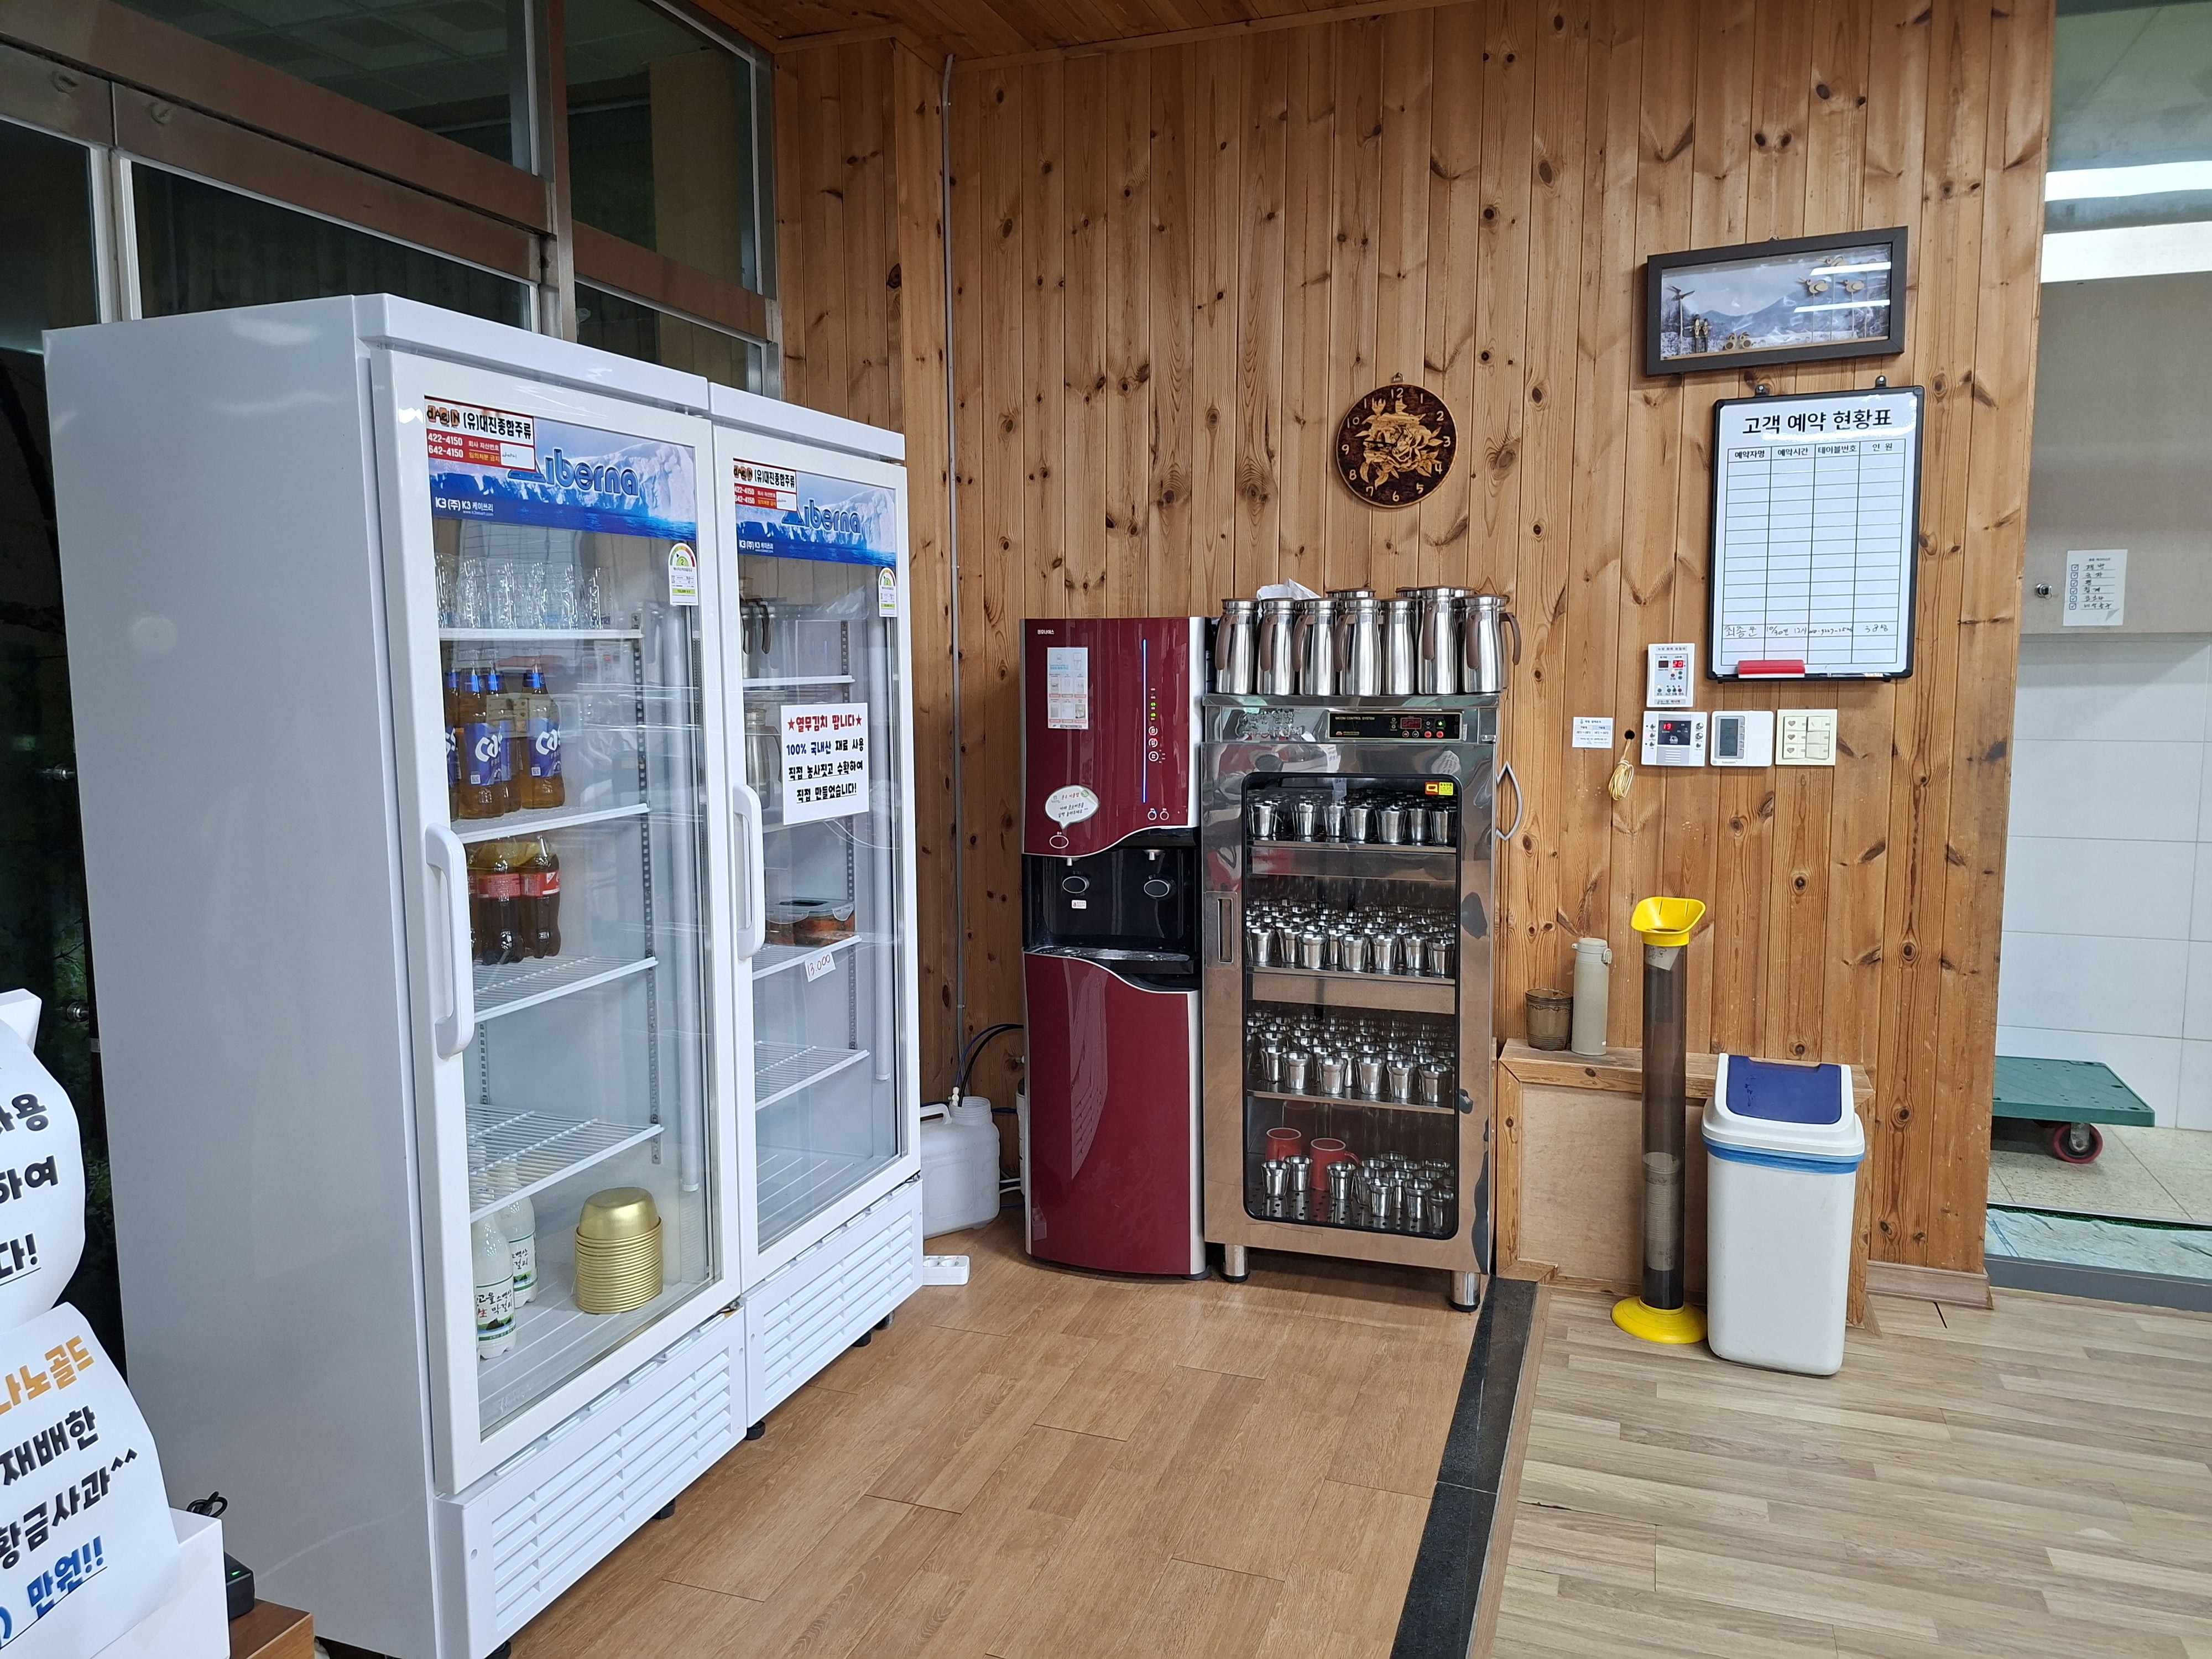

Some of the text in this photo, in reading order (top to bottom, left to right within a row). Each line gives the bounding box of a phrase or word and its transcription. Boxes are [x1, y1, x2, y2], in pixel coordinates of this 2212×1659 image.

[1391, 388, 1404, 399] 12
[1420, 393, 1423, 404] 1
[1437, 410, 1444, 421] 2
[1743, 409, 1892, 434] 고객 예약 현황표
[463, 412, 531, 440] (유)대진종합주류
[1347, 416, 1360, 429] 10
[428, 433, 462, 446] 422-4150
[1443, 436, 1451, 447] 3
[429, 445, 463, 458] 642-4150
[479, 442, 499, 451] 자산번호
[1342, 444, 1349, 455] 9
[1734, 450, 1765, 459] 예약자명
[1777, 447, 1808, 457] 예약시간
[1818, 444, 1857, 454] 테이블번호
[1349, 469, 1357, 481] 8
[1435, 463, 1443, 474] 4
[755, 469, 795, 488] (유)대진종합주류
[1366, 486, 1374, 497] 7
[1416, 482, 1424, 494] 5
[1392, 491, 1399, 502] 6
[435, 497, 446, 508] K3
[448, 499, 461, 512] (주)
[462, 500, 471, 510] K3
[796, 714, 854, 733] 열무김치 팝니다
[786, 737, 864, 756] 100% 국내산 재료 사용
[789, 760, 863, 780] 직접 농사짓고 수확하여
[796, 782, 857, 803] 직접 만들었습니다!
[513, 1258, 528, 1270] 걸리
[0, 1405, 99, 1486] 재배한
[27, 1535, 103, 1619] 만원!!
